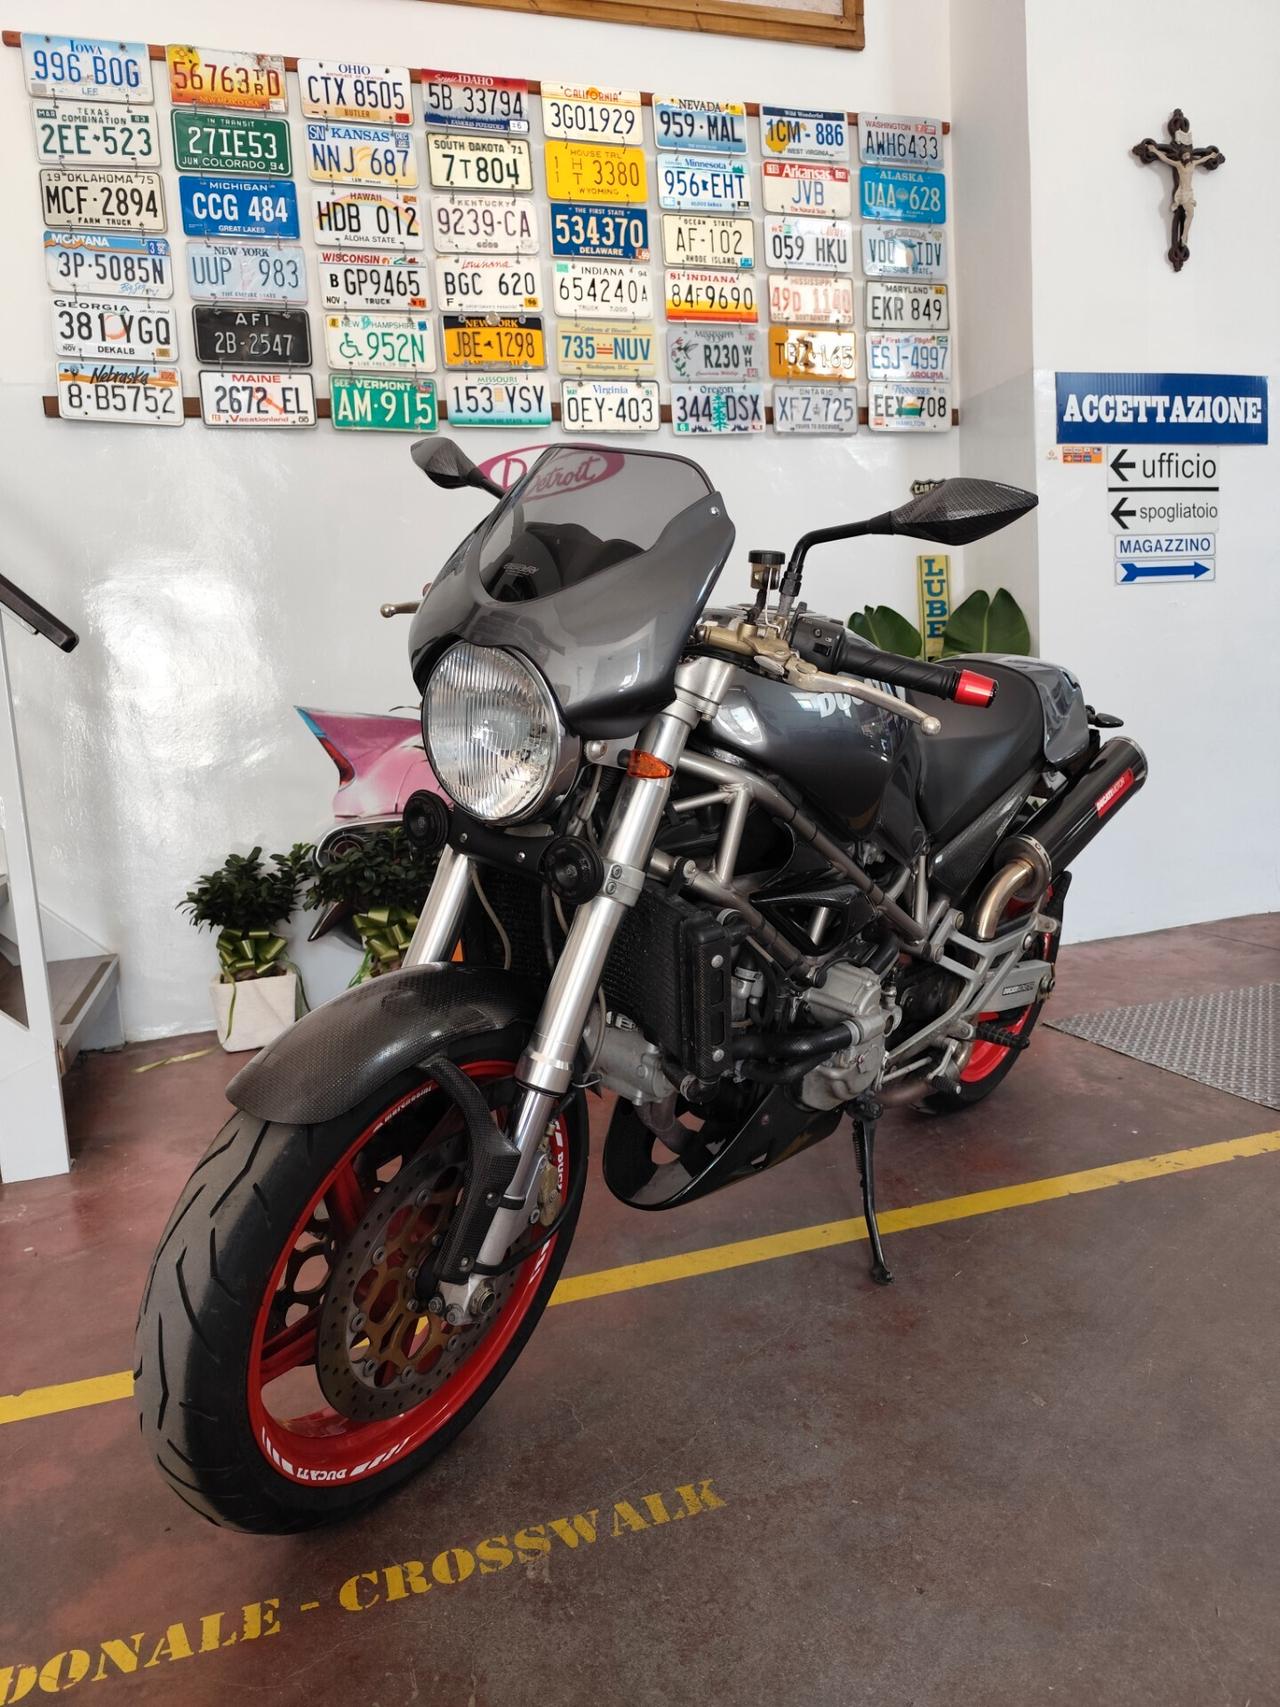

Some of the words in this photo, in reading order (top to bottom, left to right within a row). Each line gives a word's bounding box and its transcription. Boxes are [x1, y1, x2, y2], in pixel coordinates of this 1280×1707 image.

[33, 50, 82, 83] 996
[338, 64, 370, 75] OHIO
[173, 61, 250, 94] 56763
[458, 75, 494, 86] IDAHO
[307, 76, 347, 106] CTX
[353, 79, 405, 110] 8505
[564, 88, 619, 102] CALIFORNIA
[428, 83, 453, 111] 5B
[463, 87, 524, 118] 33794
[678, 99, 721, 112] NEVADA
[77, 108, 110, 116] TEXAS
[61, 115, 127, 125] COMBINATION
[221, 119, 255, 127] TRANSIT
[865, 120, 912, 131] WASHINGTON
[331, 128, 390, 142] KANSAS
[434, 140, 465, 150] SOUTH
[469, 142, 505, 153] DAKOTA
[511, 145, 523, 154] 71
[866, 130, 938, 160] AWH6433
[312, 143, 354, 173] NNJ
[370, 148, 408, 177] 687
[570, 149, 602, 158] HOUSE
[182, 157, 199, 165] JUN
[202, 158, 265, 169] COLORADO
[685, 158, 726, 169] Minnesota
[68, 173, 133, 184] OKLAHOMA
[139, 176, 154, 184] 75
[593, 160, 640, 187] 3380
[782, 165, 831, 179] Arkansas
[880, 170, 923, 183] ALASKA
[209, 182, 268, 192] MICHIGAN
[578, 188, 620, 196] WYOMING
[792, 180, 824, 205] JVB
[350, 192, 382, 202] HAWAII
[909, 186, 941, 212] 628
[192, 192, 238, 221] CCG
[248, 196, 288, 222] 484
[589, 208, 605, 216] FIRST
[106, 218, 131, 226] TRUCK
[318, 201, 361, 233] HDB
[376, 206, 419, 236] 012
[242, 226, 266, 234] LAKES
[555, 215, 644, 247] 534370
[51, 233, 110, 247] MONTANA
[344, 235, 370, 243] ALOHA
[372, 235, 396, 243] STATE
[214, 246, 237, 256] NEW
[240, 246, 270, 257] YORK
[579, 246, 623, 256] DELAWARE
[816, 237, 847, 263] HKU
[322, 253, 380, 264] WISCONSIN
[686, 255, 707, 263] RHODE
[192, 256, 232, 286] UUP
[258, 259, 299, 288] 983
[581, 267, 624, 276] INDIANA
[445, 272, 482, 296] BGC
[498, 272, 535, 296] 620
[687, 274, 736, 283] INDIANA
[885, 285, 928, 294] MARYLAND
[54, 300, 130, 311] GEORGIA
[326, 296, 340, 304] NOV
[872, 296, 904, 320] EKR
[911, 299, 941, 320] 849
[236, 313, 270, 326] AFI
[341, 320, 360, 328] NEW
[371, 321, 416, 329] HAMPSHIRE
[120, 315, 170, 345] YGQ
[97, 346, 135, 354] DEKALB
[367, 332, 424, 363] 952N
[704, 345, 740, 368] R230
[90, 365, 149, 385] Nebraska
[232, 375, 281, 383] MAINE
[355, 380, 412, 390] VERMONT
[593, 385, 628, 394] Virginia
[700, 386, 734, 395] Oregon
[215, 386, 268, 414] 2672
[281, 387, 308, 414] EL
[1063, 394, 1262, 424] ACCETTAZIONE
[229, 415, 289, 423] Vacationland
[1142, 452, 1217, 479] ufficio
[1139, 503, 1218, 522] spogliatoio
[1119, 537, 1211, 554] MAGAZZINO
[296, 1467, 348, 1481] DUCATI
[338, 1478, 727, 1612] CROSSWALK
